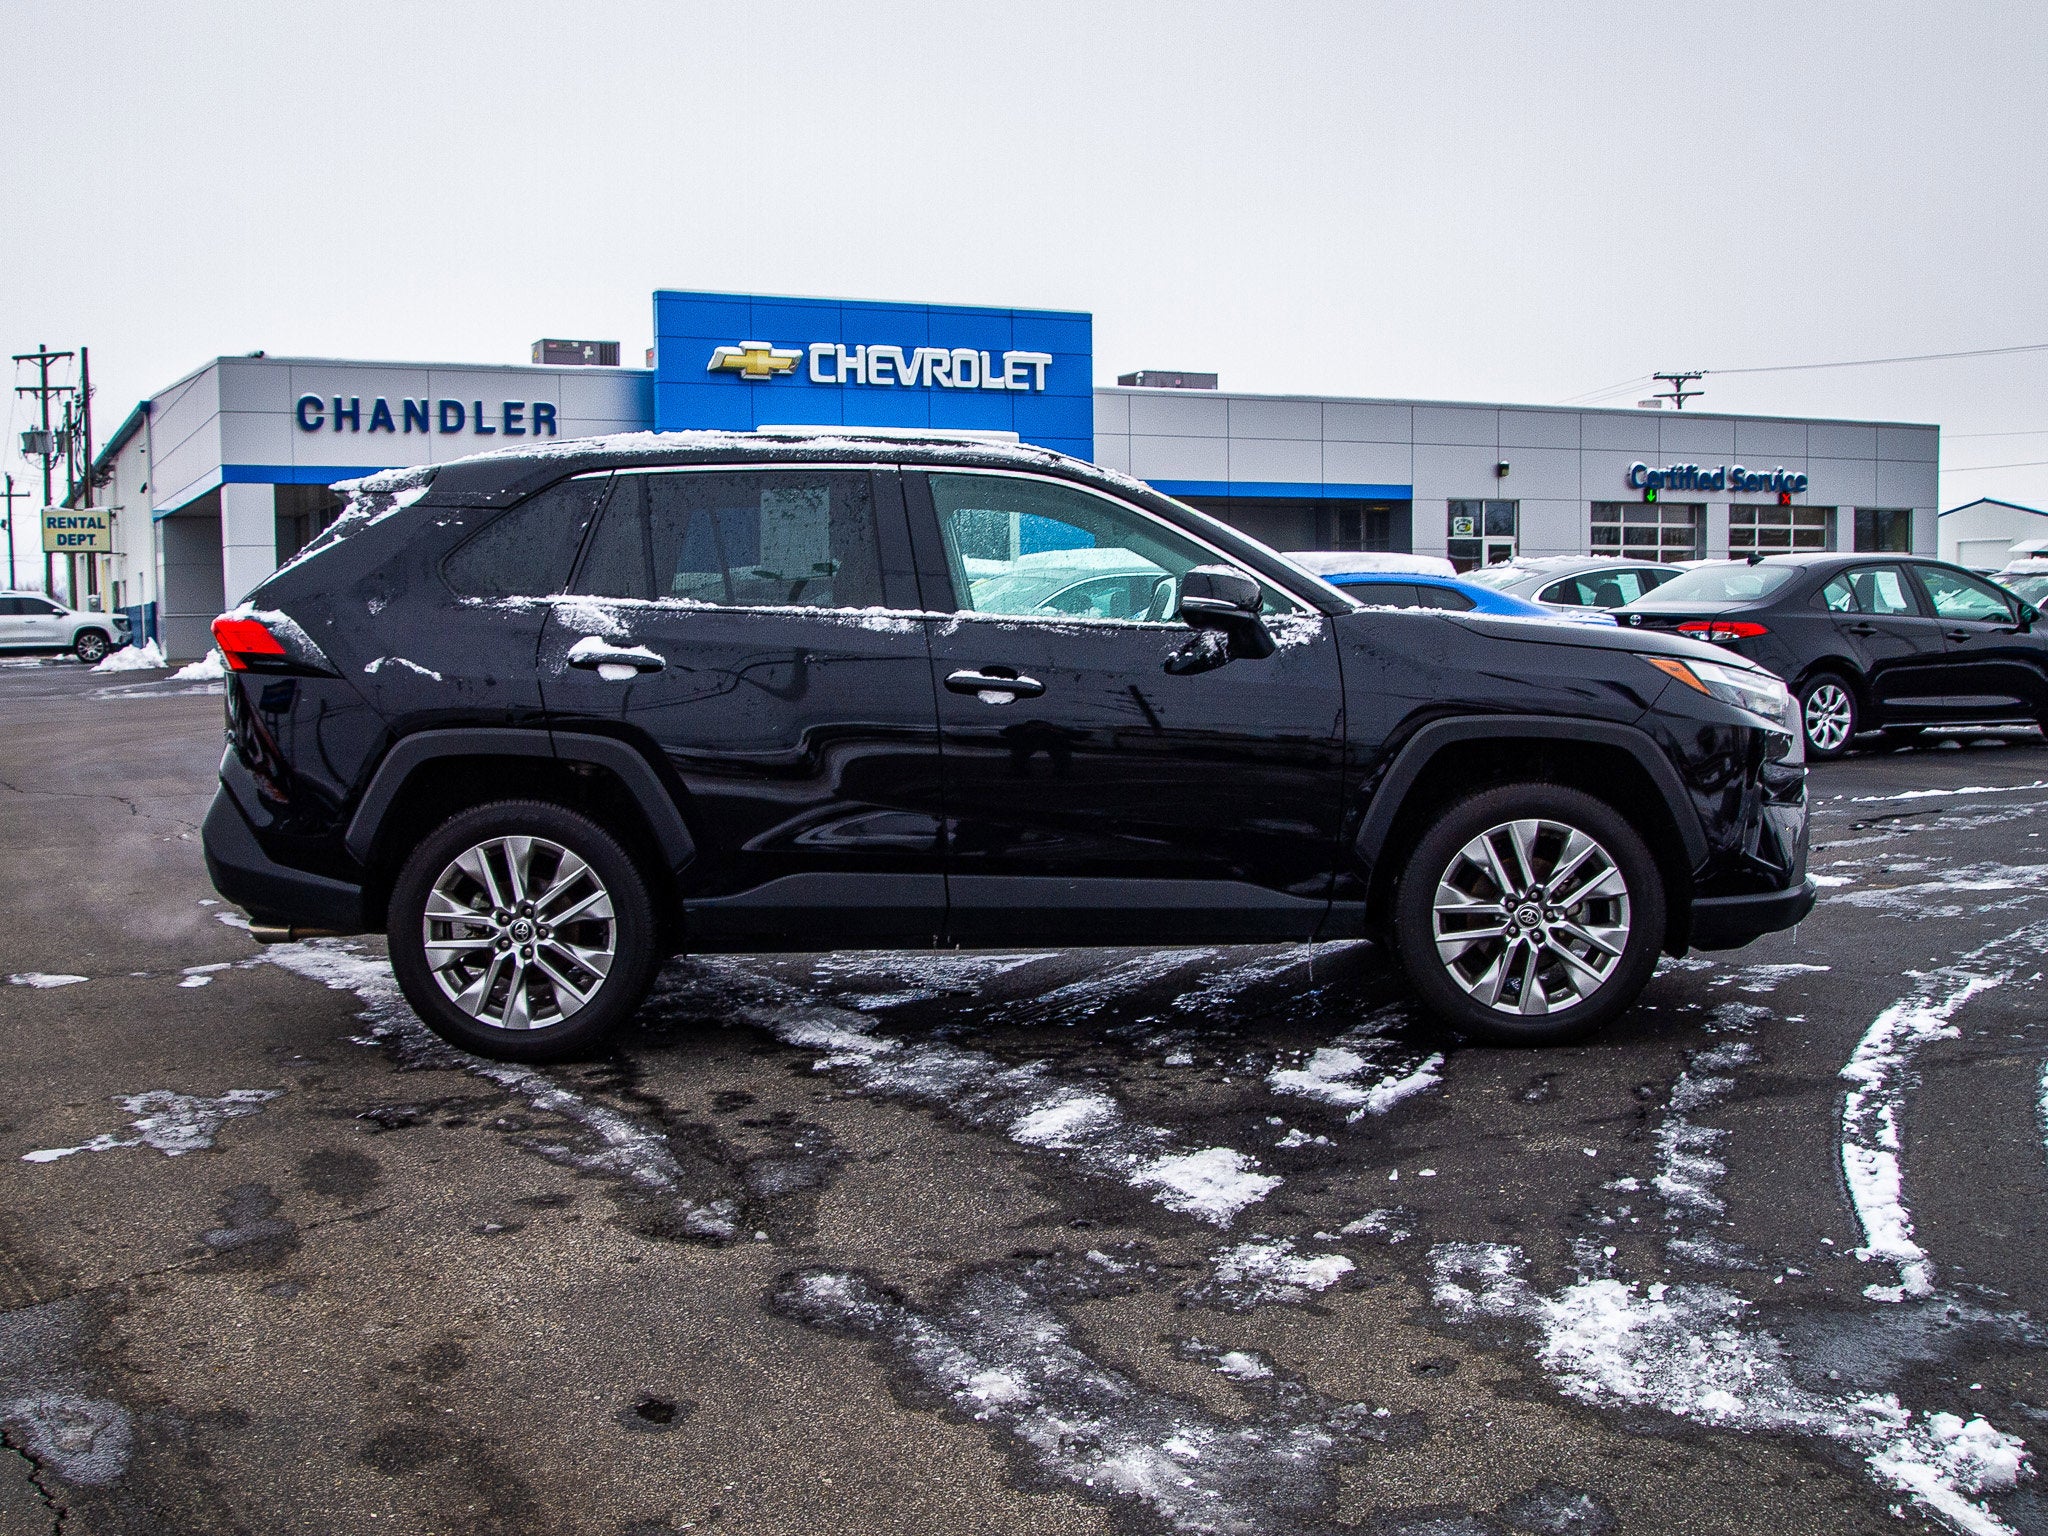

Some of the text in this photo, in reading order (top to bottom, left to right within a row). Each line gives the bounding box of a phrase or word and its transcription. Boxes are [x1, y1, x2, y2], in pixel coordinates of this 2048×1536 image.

[808, 343, 1052, 391] CHEVROLET
[297, 394, 557, 436] CHANDLER
[1629, 462, 1808, 492] Certified Service
[46, 516, 106, 529] RENTAL
